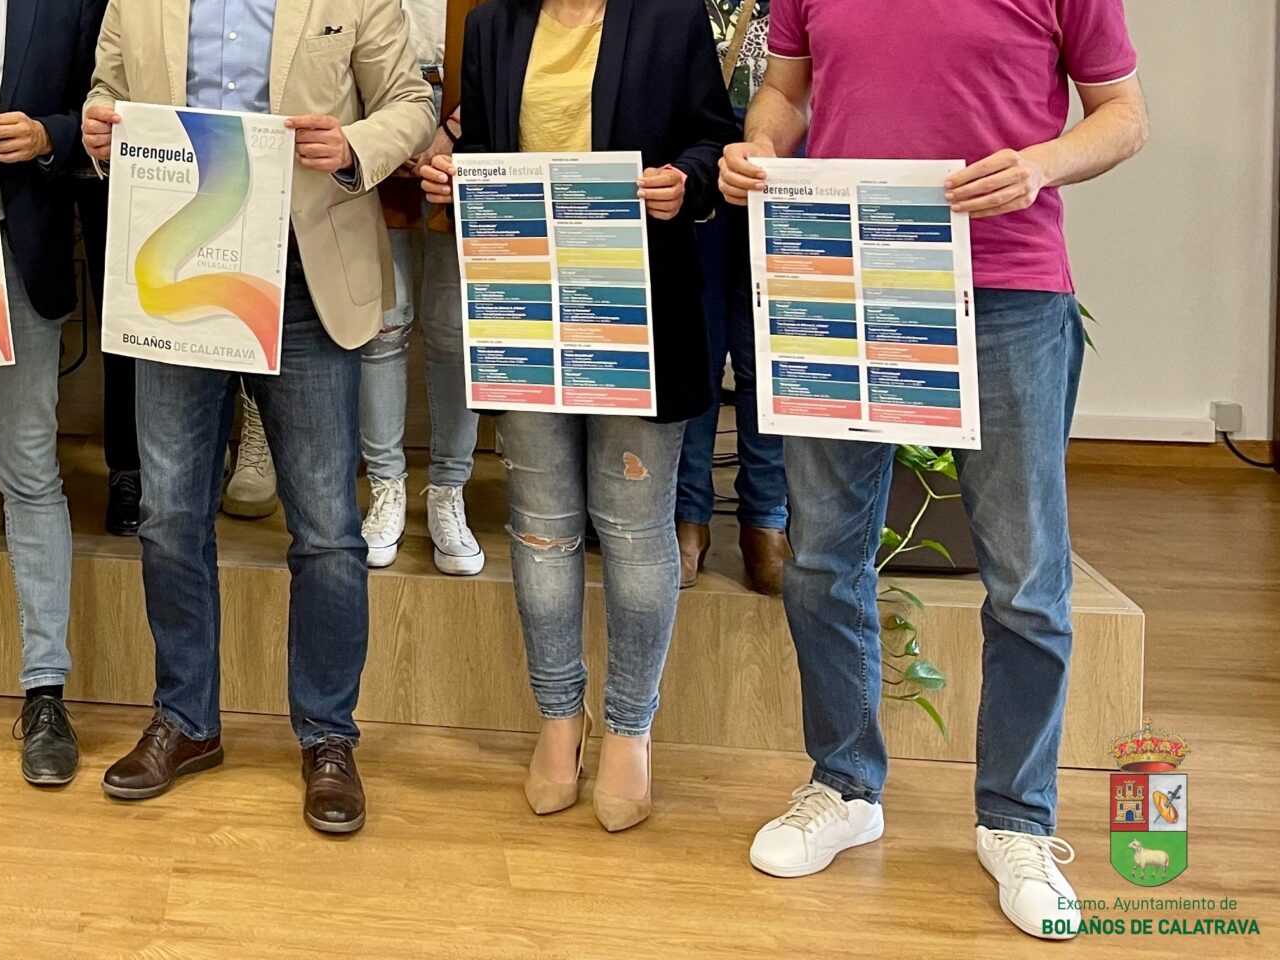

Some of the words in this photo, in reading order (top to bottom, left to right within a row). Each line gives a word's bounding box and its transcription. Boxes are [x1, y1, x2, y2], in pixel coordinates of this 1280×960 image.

[250, 134, 286, 150] 2022
[120, 142, 195, 163] Berenguela
[130, 163, 191, 185] festival
[457, 166, 507, 178] Berenguela
[508, 165, 543, 176] festival
[816, 186, 850, 197] festival
[197, 247, 239, 262] ARTES
[122, 332, 172, 351] BOLAÑOS
[173, 342, 189, 353] DE
[189, 343, 256, 360] CALATRAVA
